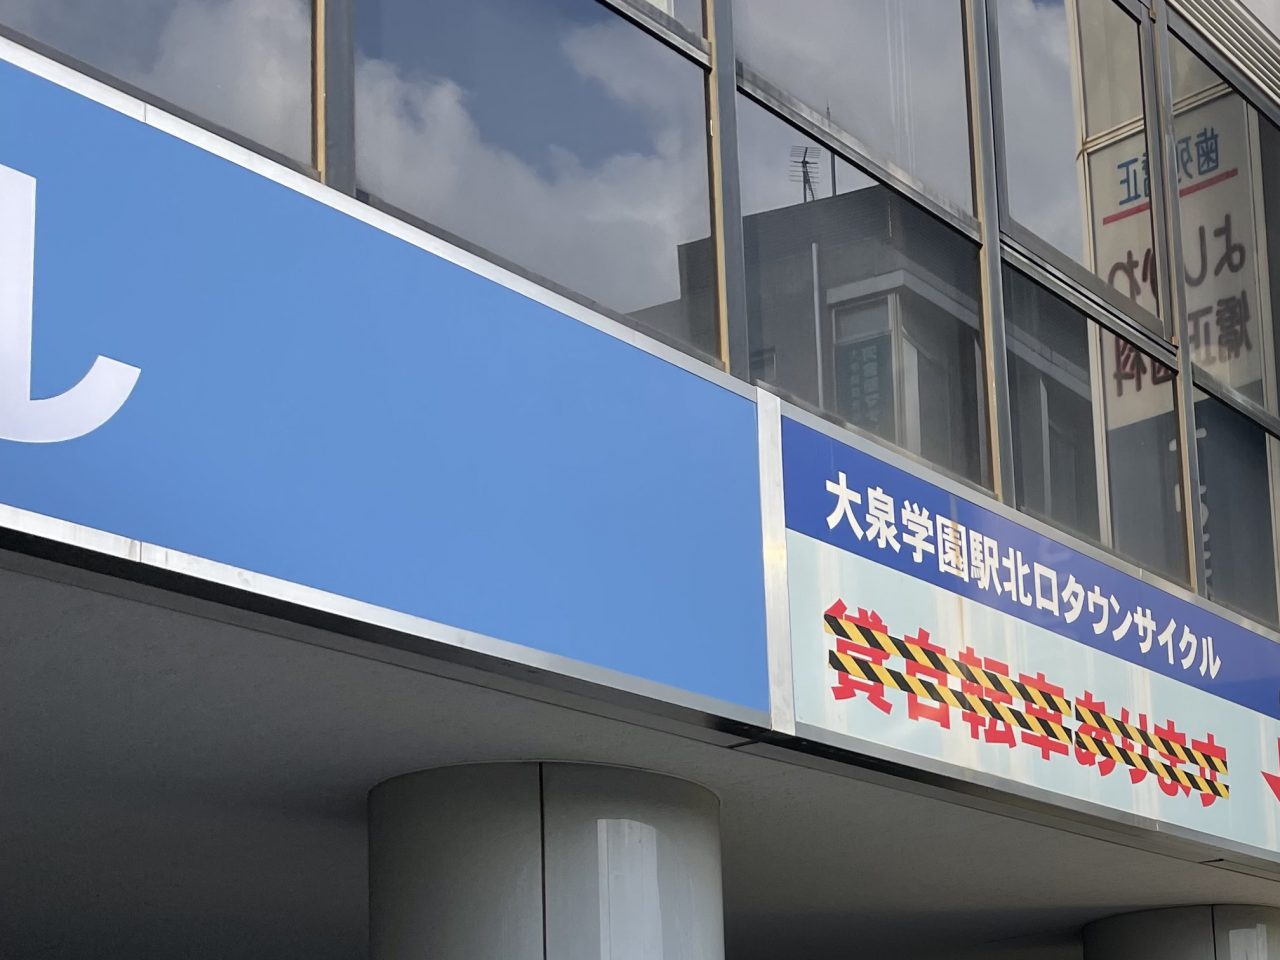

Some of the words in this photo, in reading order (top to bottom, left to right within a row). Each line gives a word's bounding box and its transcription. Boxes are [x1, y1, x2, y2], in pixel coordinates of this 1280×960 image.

[824, 471, 1222, 680] 大泉学園駅北口タウンサイクル
